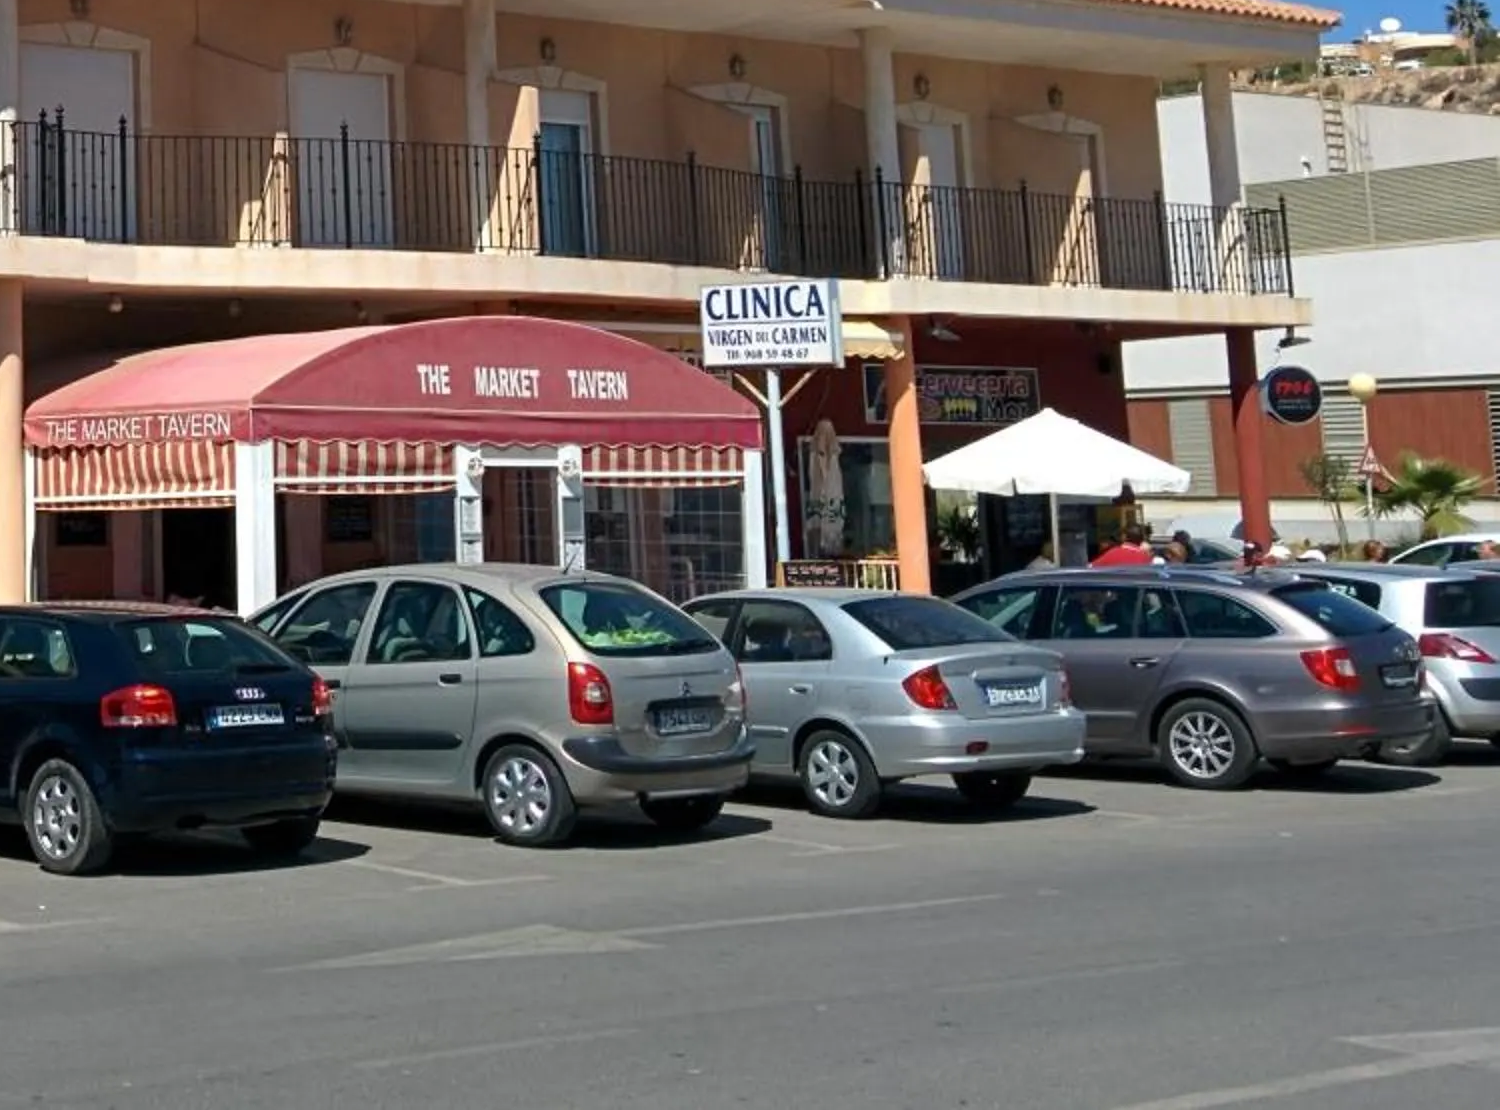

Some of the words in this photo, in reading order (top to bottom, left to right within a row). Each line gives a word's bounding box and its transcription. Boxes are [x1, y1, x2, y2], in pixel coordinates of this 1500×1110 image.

[705, 284, 825, 321] CLINICA
[707, 329, 753, 347] VIRGEN
[771, 327, 827, 345] CARMEN
[416, 364, 451, 395] THE
[474, 366, 540, 400] MARKET
[567, 369, 629, 400] TAVERN
[45, 419, 77, 443] THE
[81, 416, 153, 442] MARKET
[157, 412, 232, 439] TAVERN
